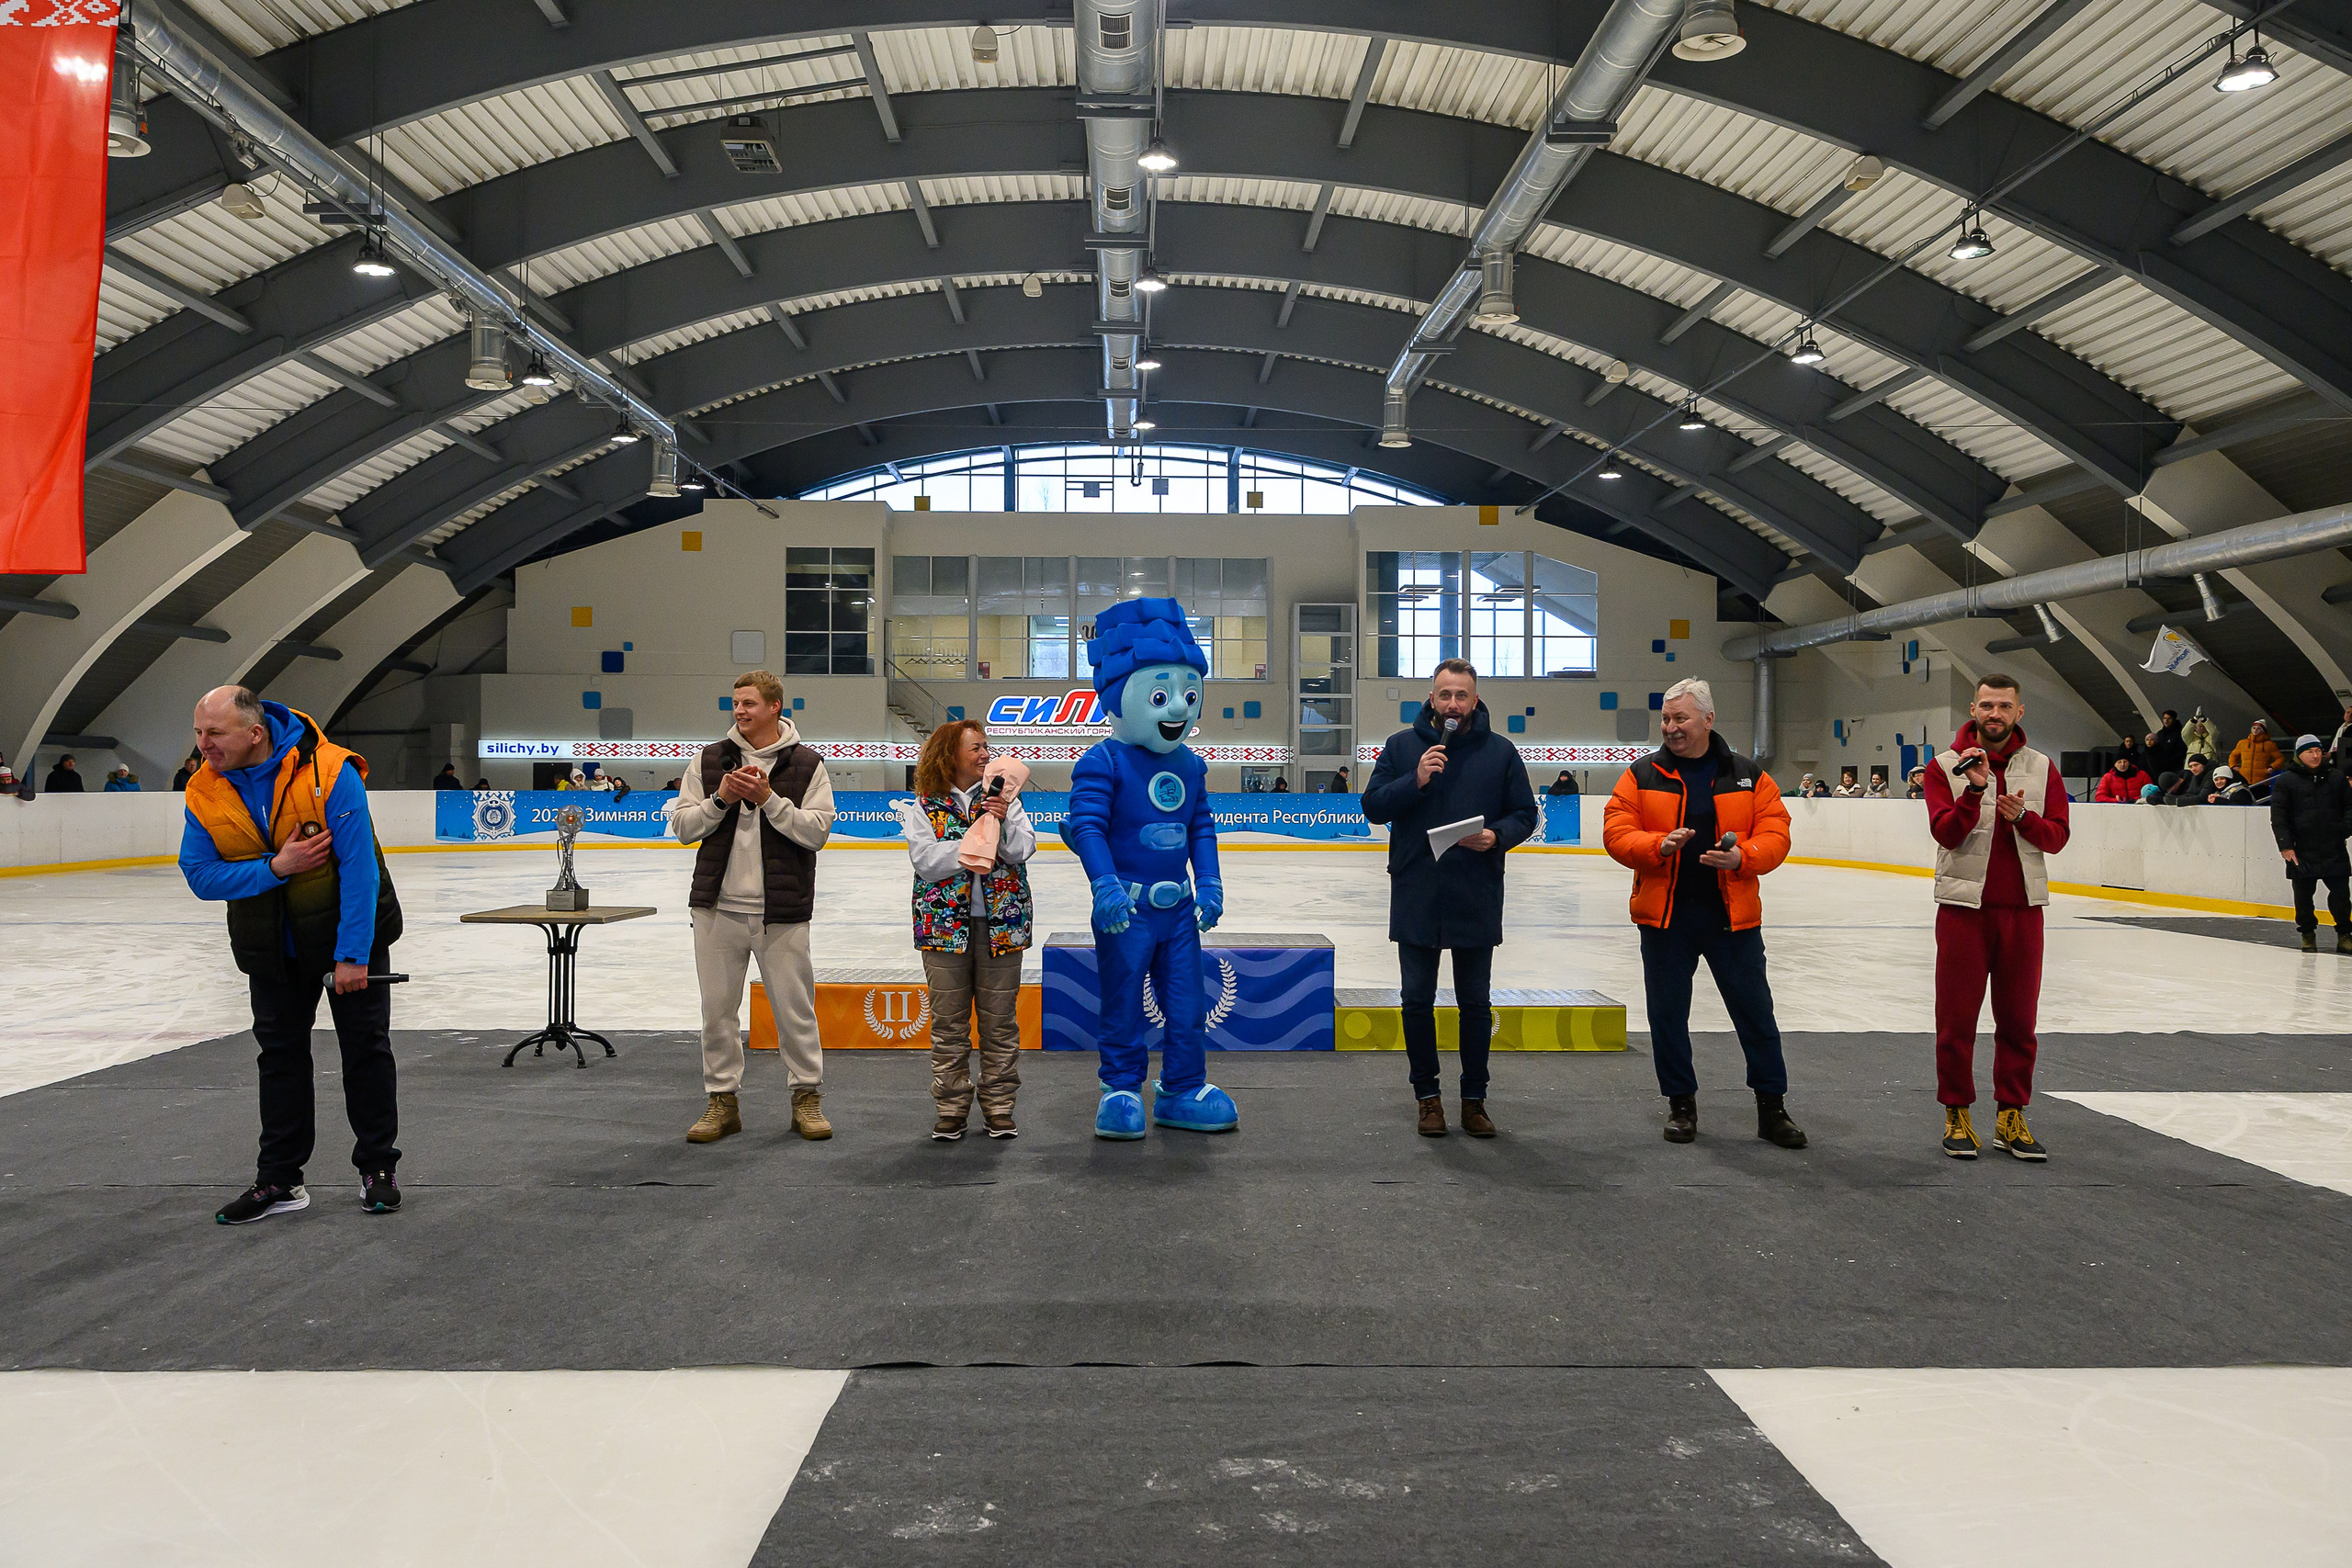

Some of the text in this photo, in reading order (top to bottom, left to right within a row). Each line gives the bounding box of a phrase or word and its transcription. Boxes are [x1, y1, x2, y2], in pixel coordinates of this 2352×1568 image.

[986, 726, 1085, 735] РЕСПУБЛИКАНСКИЙ
[487, 742, 560, 755] silichy.by
[531, 807, 560, 822] 202
[585, 807, 647, 822] Зимняя
[1210, 812, 1269, 826] идента
[1272, 809, 1365, 827] Республики
[881, 991, 912, 1022] II
